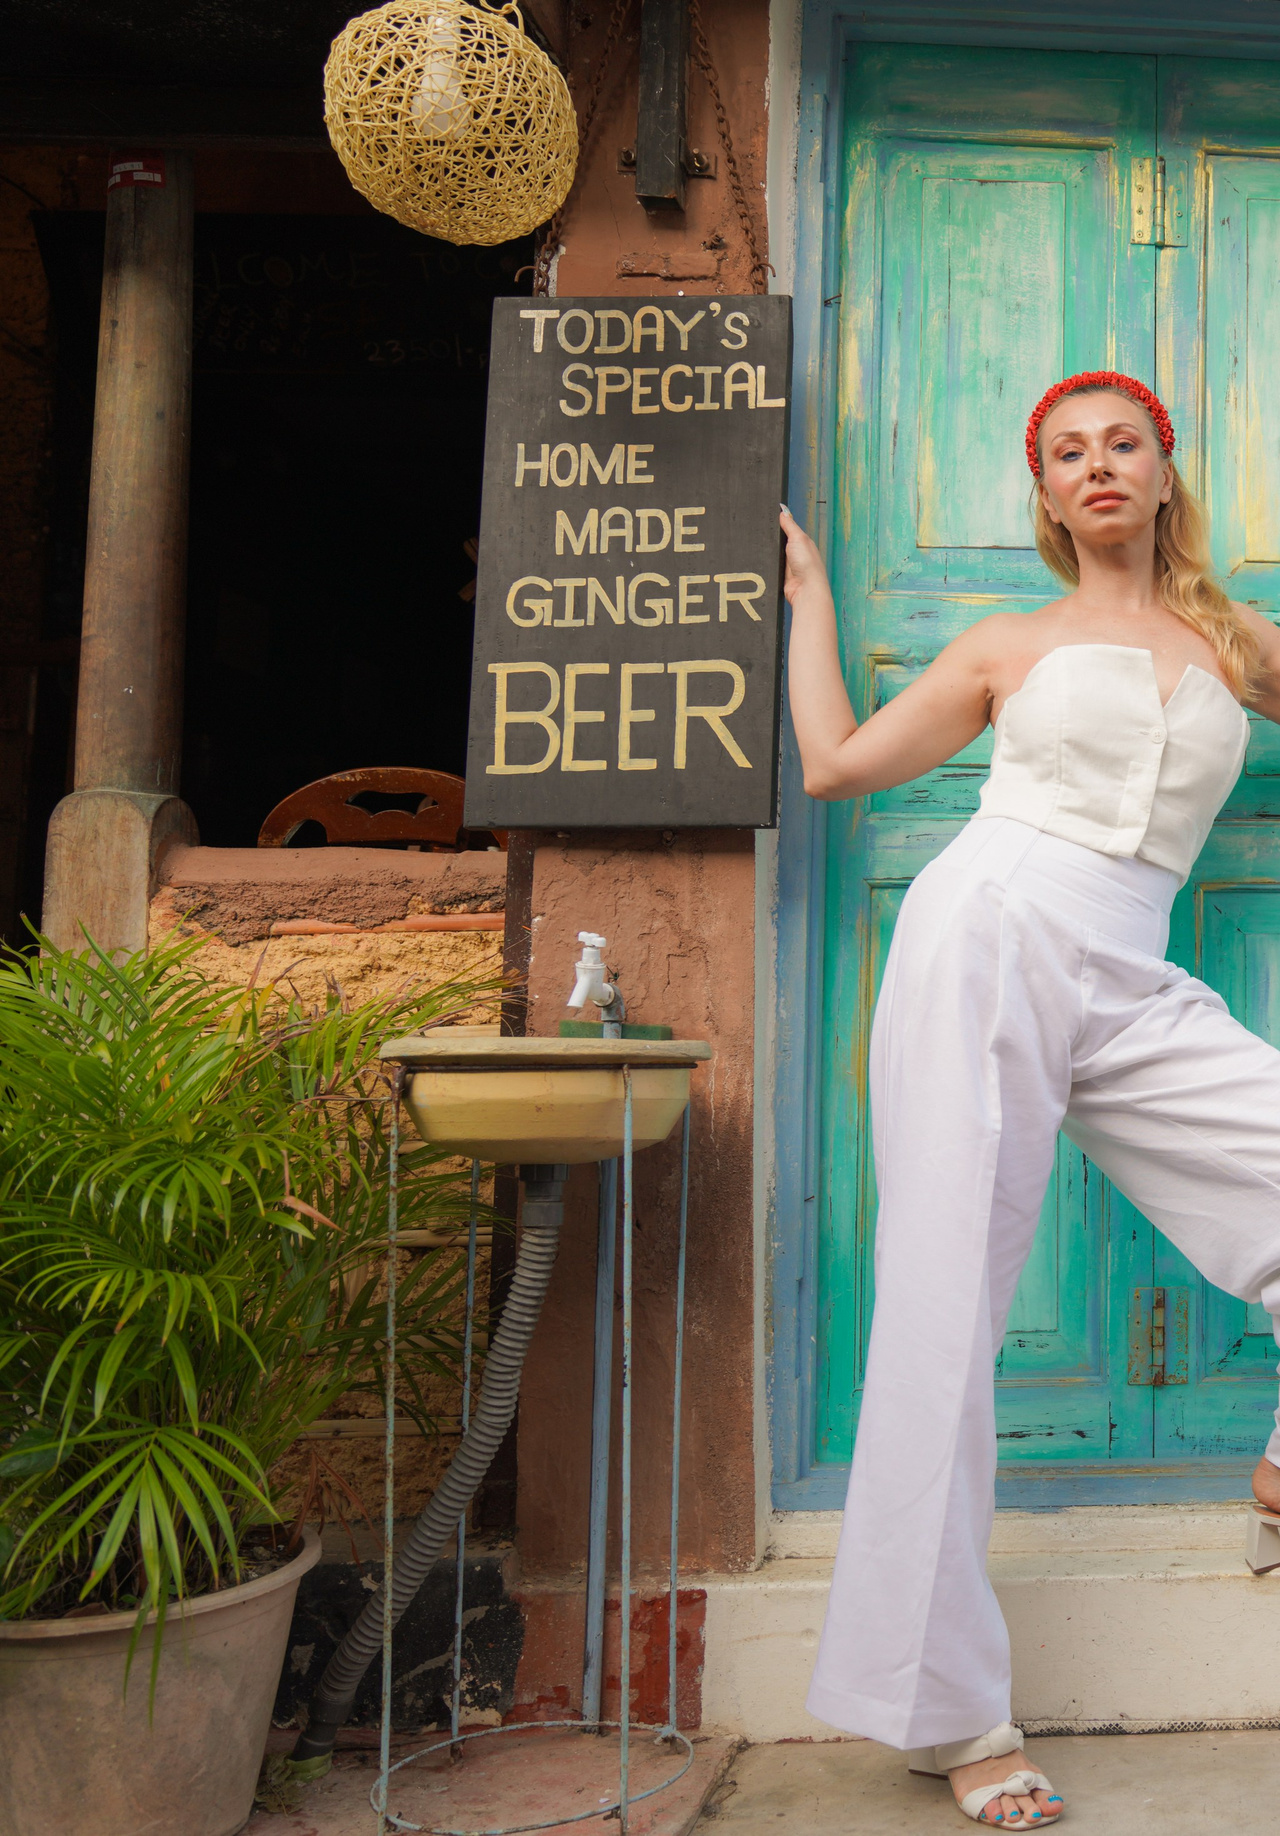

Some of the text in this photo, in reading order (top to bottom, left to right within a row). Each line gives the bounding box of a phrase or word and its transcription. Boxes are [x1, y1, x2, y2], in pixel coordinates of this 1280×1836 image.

[520, 302, 750, 354] TODAY'S
[559, 361, 786, 417] SPECIAL
[515, 443, 654, 487] HOME
[555, 506, 705, 555] MADE
[506, 572, 766, 627] GINGER
[486, 659, 753, 775] BEER
